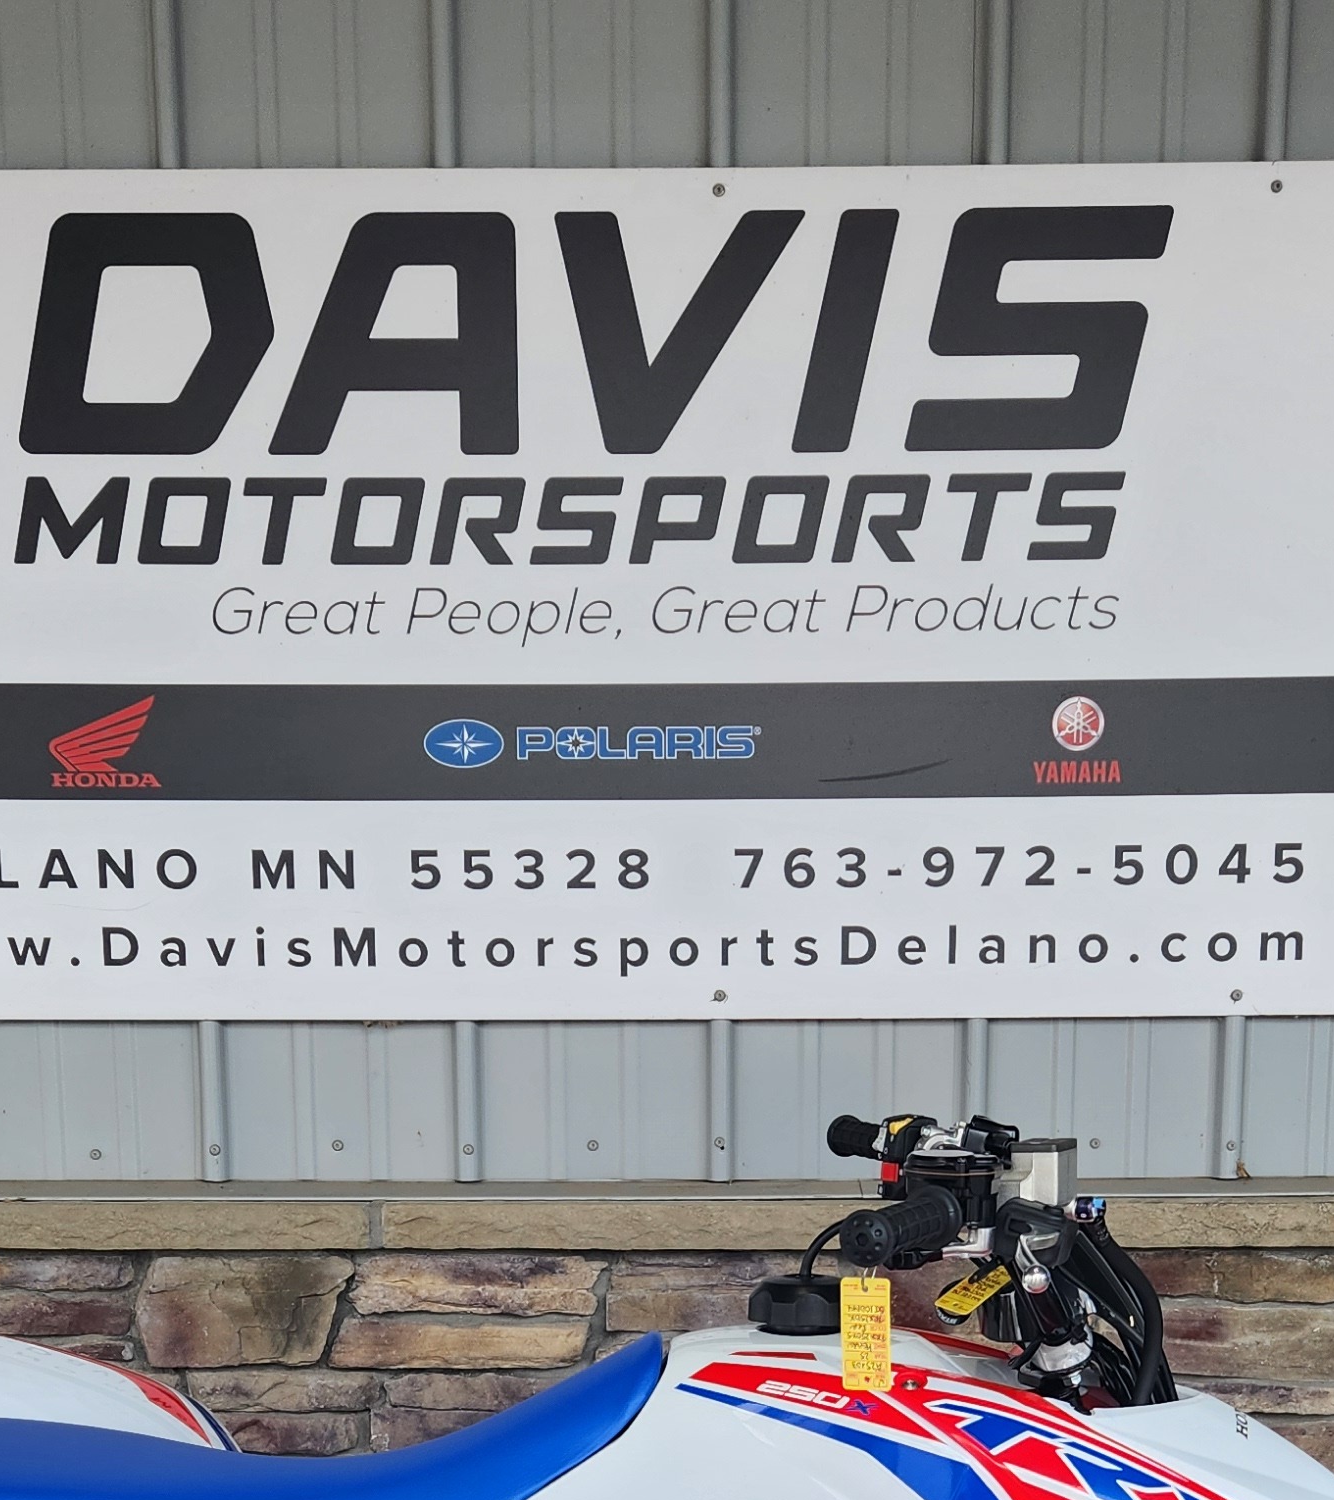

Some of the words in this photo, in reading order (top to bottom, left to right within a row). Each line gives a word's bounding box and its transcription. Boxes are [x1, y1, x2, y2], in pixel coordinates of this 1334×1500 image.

[19, 205, 1174, 455] DAVIS
[14, 471, 1126, 565] MOTORSPORTS
[212, 587, 385, 636] Great
[407, 587, 622, 648] People,
[651, 586, 827, 635] Great
[846, 584, 1120, 633] Products
[516, 716, 755, 760] POLARIS
[51, 772, 162, 788] HONDA
[1033, 760, 1121, 784] YAMAHA
[252, 849, 354, 889] MN
[411, 848, 650, 889] 55328
[735, 843, 1303, 888] 763-972-5045
[1234, 1407, 1249, 1440] HO
